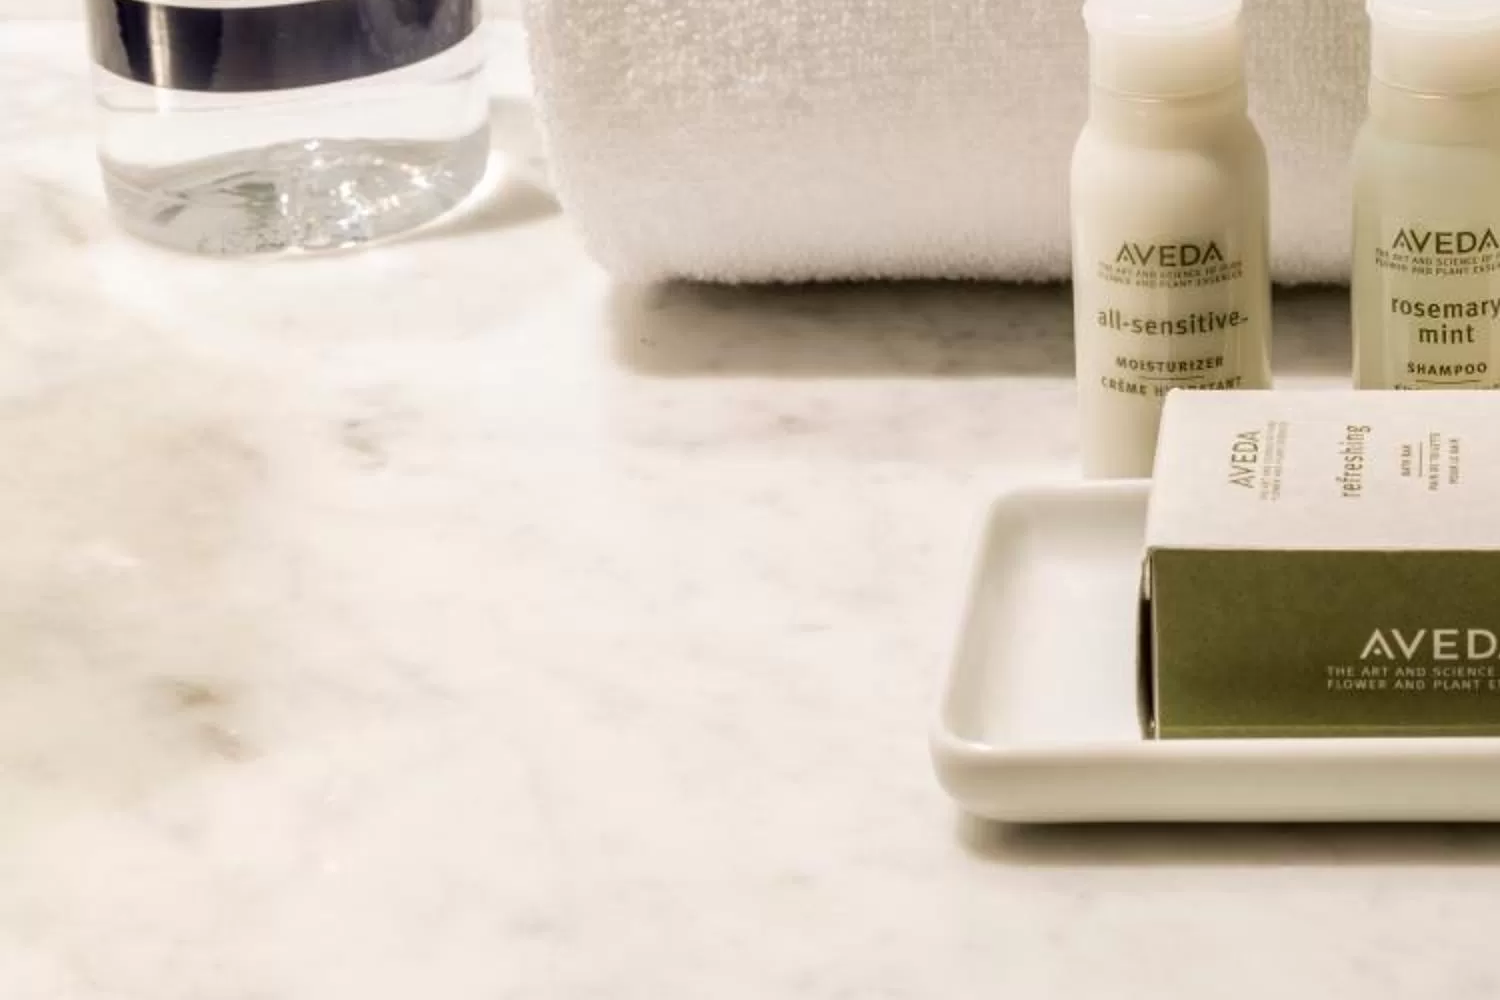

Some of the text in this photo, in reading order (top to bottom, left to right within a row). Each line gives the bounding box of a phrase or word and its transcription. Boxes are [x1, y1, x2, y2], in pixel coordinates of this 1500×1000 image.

[1391, 228, 1500, 255] AVEDA
[1116, 241, 1224, 267] AVEDA
[1418, 324, 1475, 345] mint
[1115, 355, 1224, 373] MOISTURIZER
[1407, 361, 1488, 377] SHAMPOO
[1227, 430, 1261, 490] AVEDA
[1335, 424, 1372, 499] refreshing
[1327, 666, 1354, 677] THE
[1361, 666, 1387, 677] ART
[1395, 666, 1427, 677] AND
[1432, 666, 1495, 677] SCIENCE
[1327, 679, 1388, 690] FLOWER
[1394, 679, 1426, 690] AND
[1433, 679, 1480, 690] PLANT
